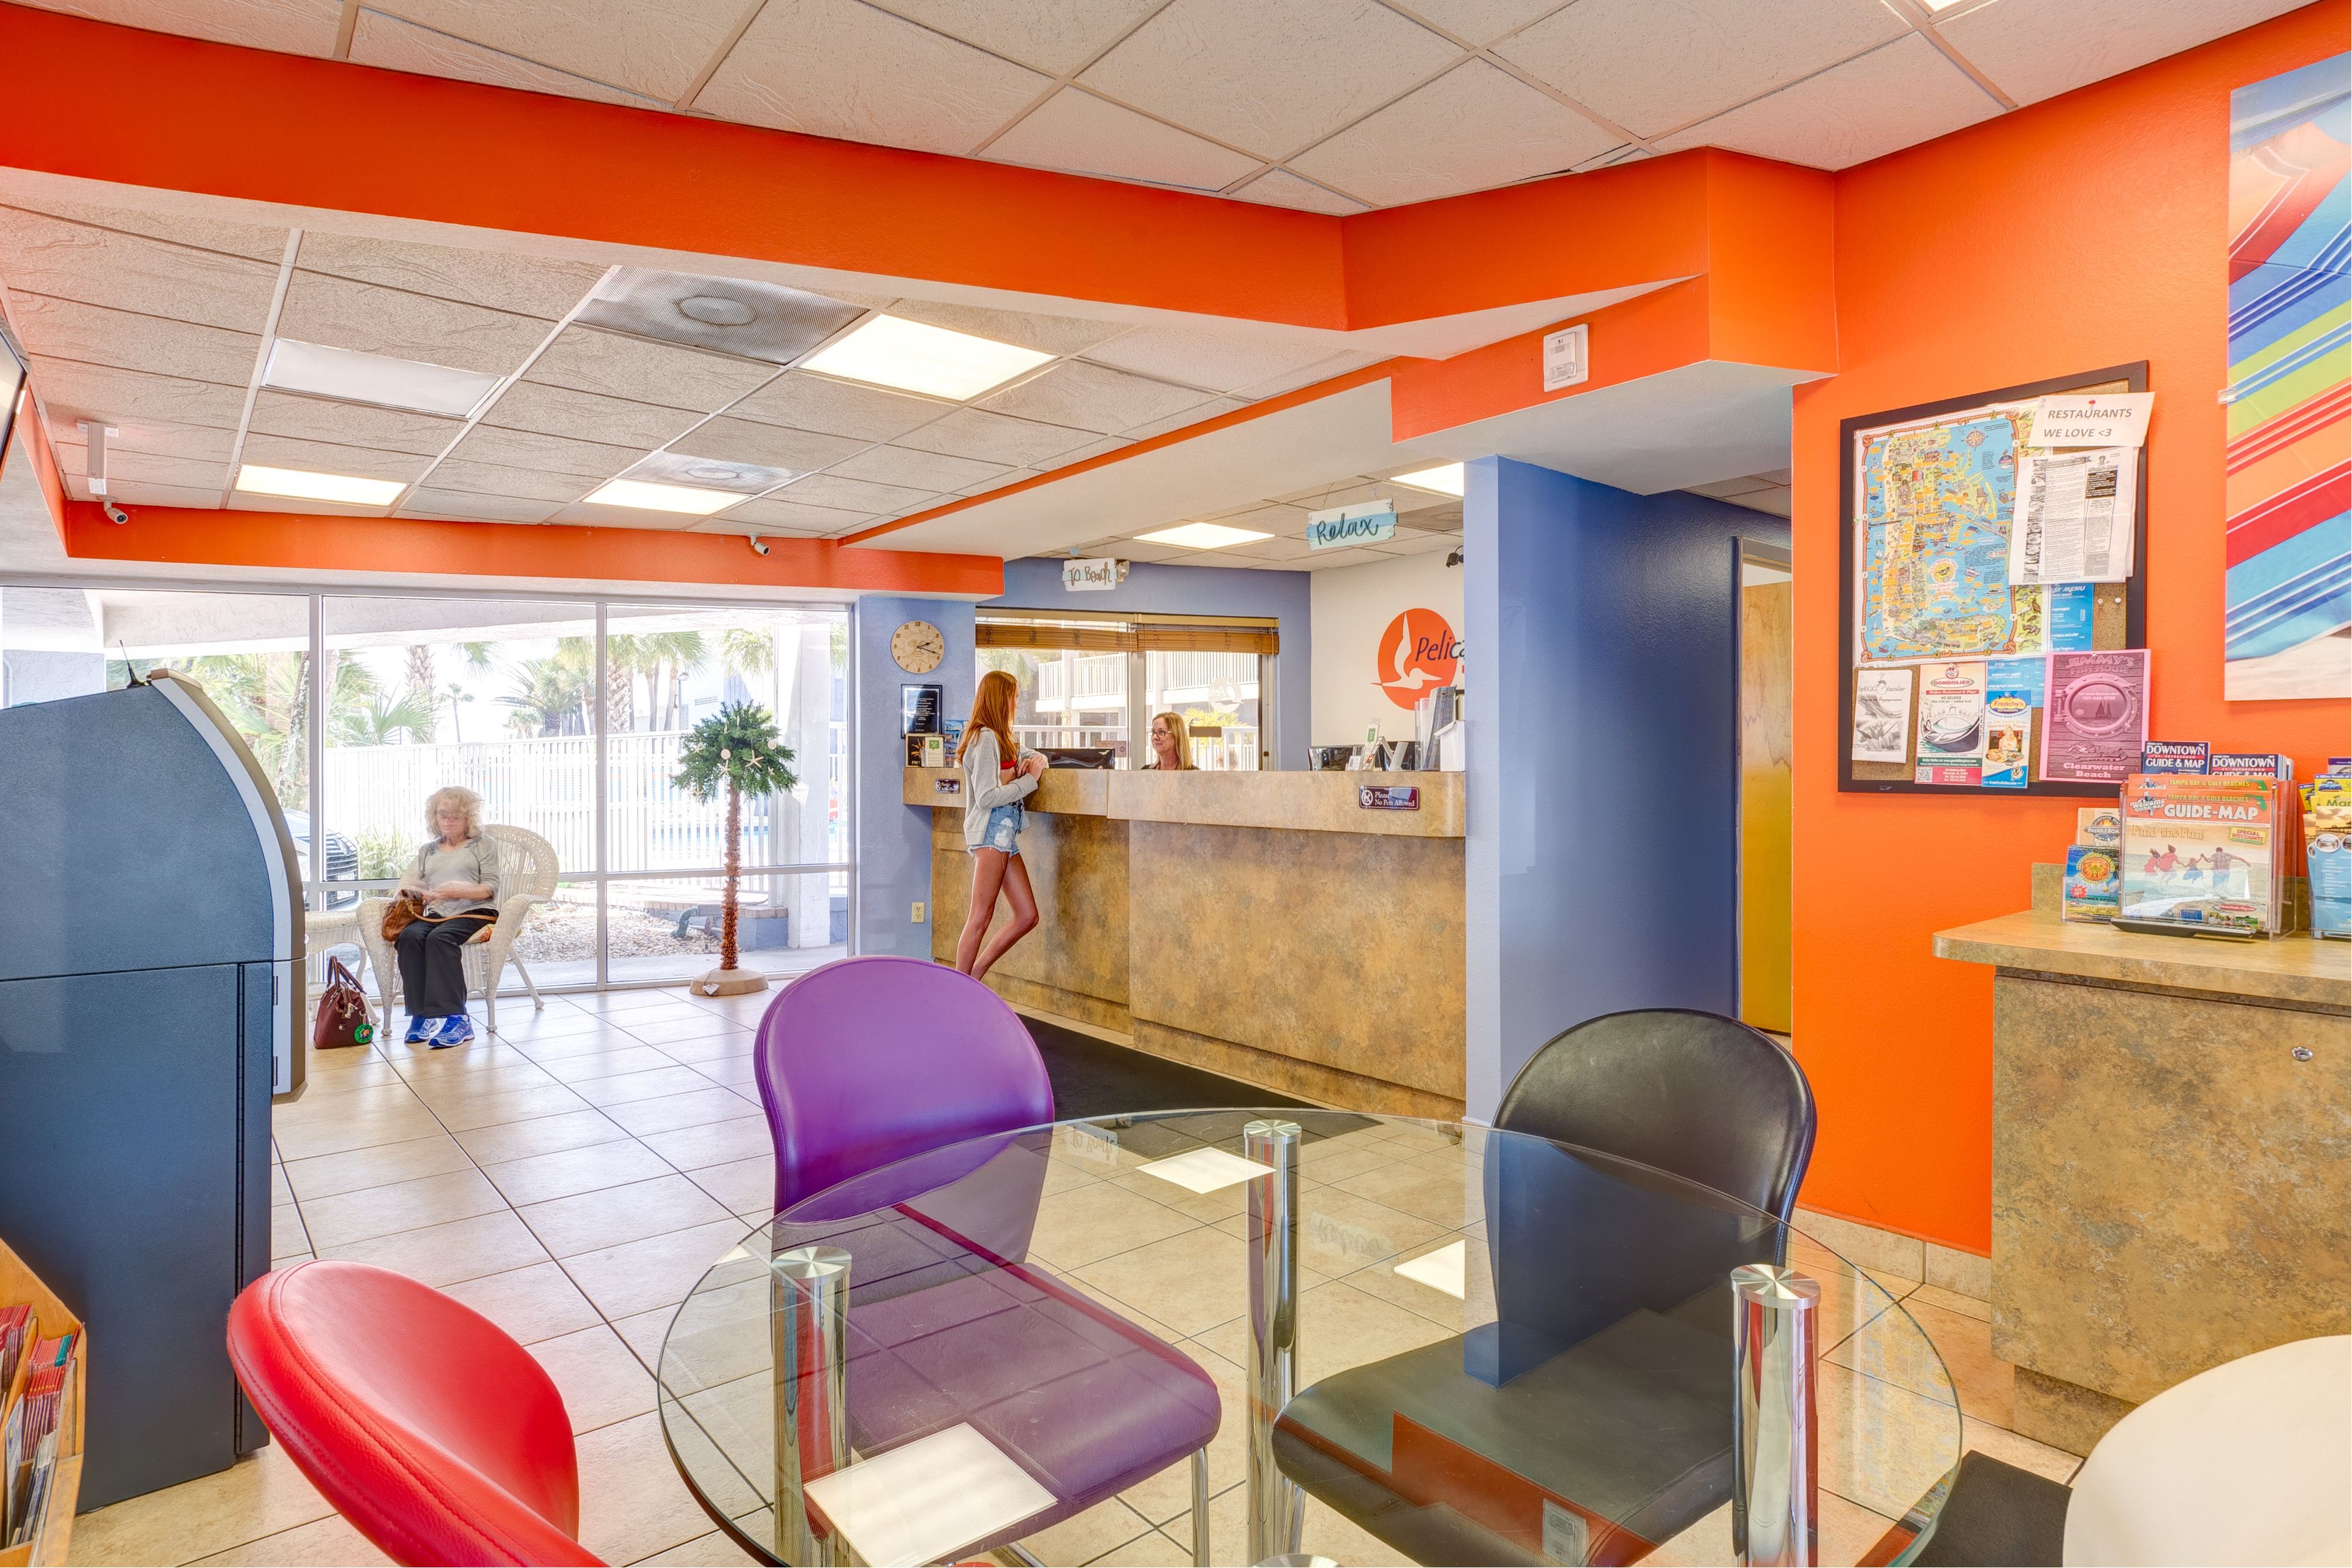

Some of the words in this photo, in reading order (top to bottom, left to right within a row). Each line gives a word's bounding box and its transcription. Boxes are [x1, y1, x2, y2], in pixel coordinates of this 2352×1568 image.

[2048, 409, 2132, 419] RESTAURANTS
[2044, 429, 2063, 438] WE
[2065, 428, 2095, 438] LOVE
[2098, 429, 2112, 437] <3
[1316, 513, 1379, 546] Relax
[1084, 562, 1112, 586] Beach
[2065, 655, 2135, 669] JIMMY'S
[2146, 745, 2206, 755] DOWNTOWN
[2063, 763, 2125, 771] Clearwater
[2145, 758, 2174, 767] GUIDE
[2175, 758, 2183, 767] &
[2184, 759, 2206, 768] MAP
[2212, 758, 2275, 767] DOWNTOWN
[2130, 799, 2165, 809] Welcome
[2163, 804, 2259, 821] GUIDE-MAP
[2131, 824, 2157, 838] Find
[2161, 827, 2179, 839] the
[2231, 833, 2264, 842] DISCOUNTS
